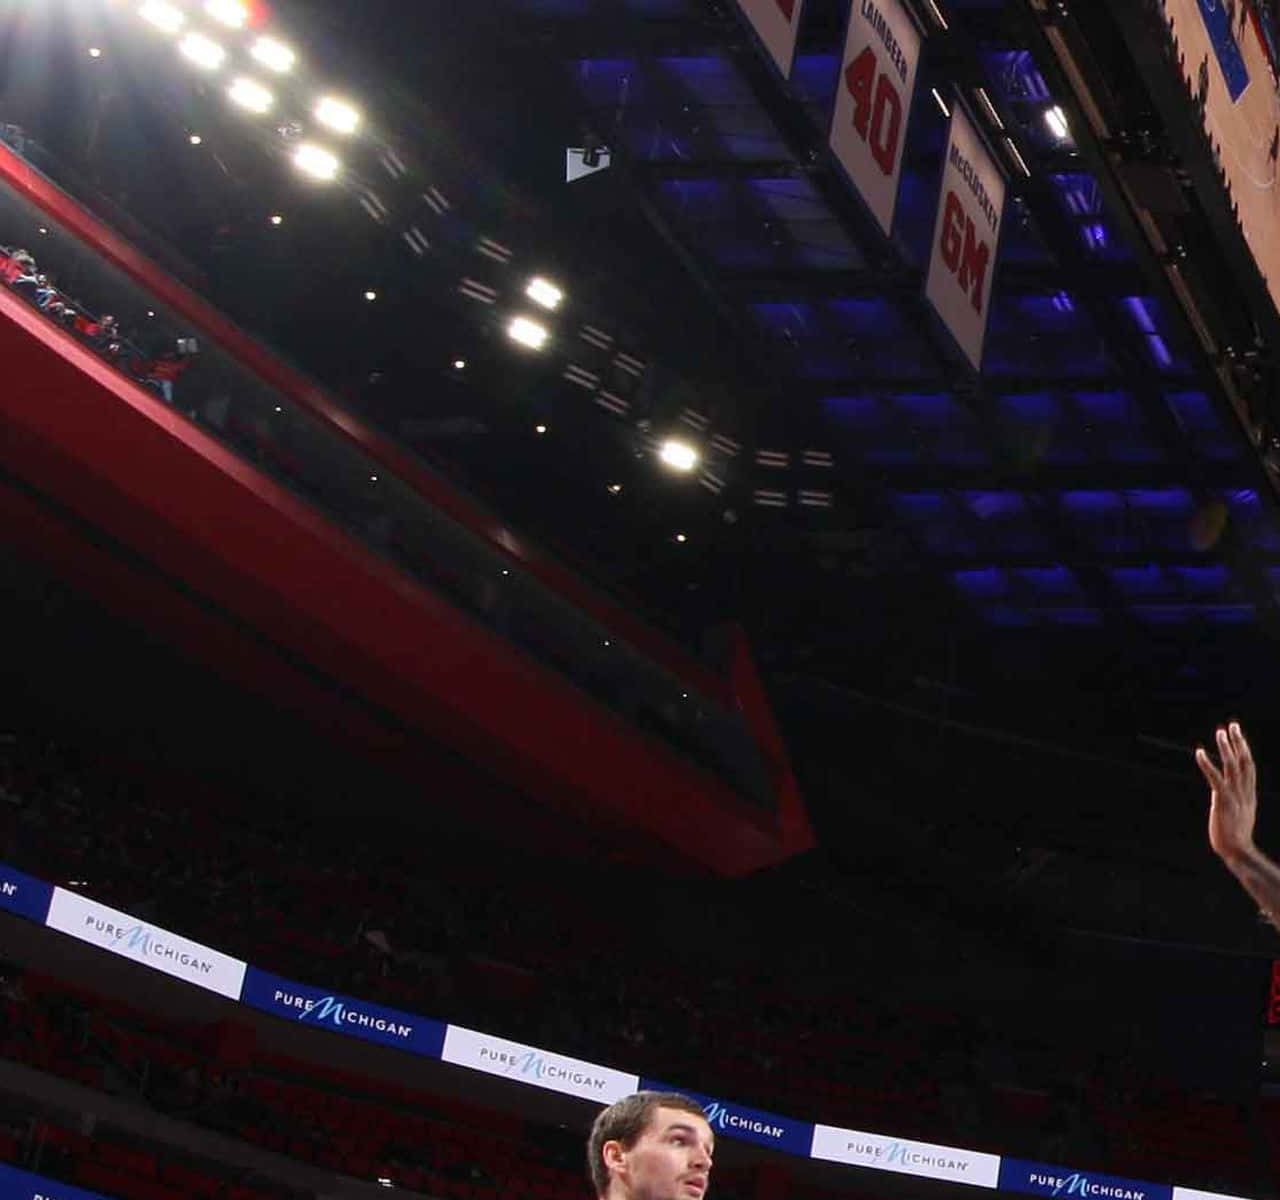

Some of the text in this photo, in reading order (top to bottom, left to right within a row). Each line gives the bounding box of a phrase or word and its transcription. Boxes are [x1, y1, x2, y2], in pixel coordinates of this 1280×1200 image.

[845, 45, 900, 176] 40
[940, 190, 990, 316] GM
[86, 915, 212, 974] PURE MICHIGAN
[274, 990, 412, 1037] PURE MICHIGAN
[479, 1047, 607, 1090] PURE MICHIGAN
[703, 1102, 784, 1137] MICHIGAN
[846, 1140, 968, 1171] PURE MICHIGAN
[1030, 1173, 1145, 1200] PURE MICHIGAN
